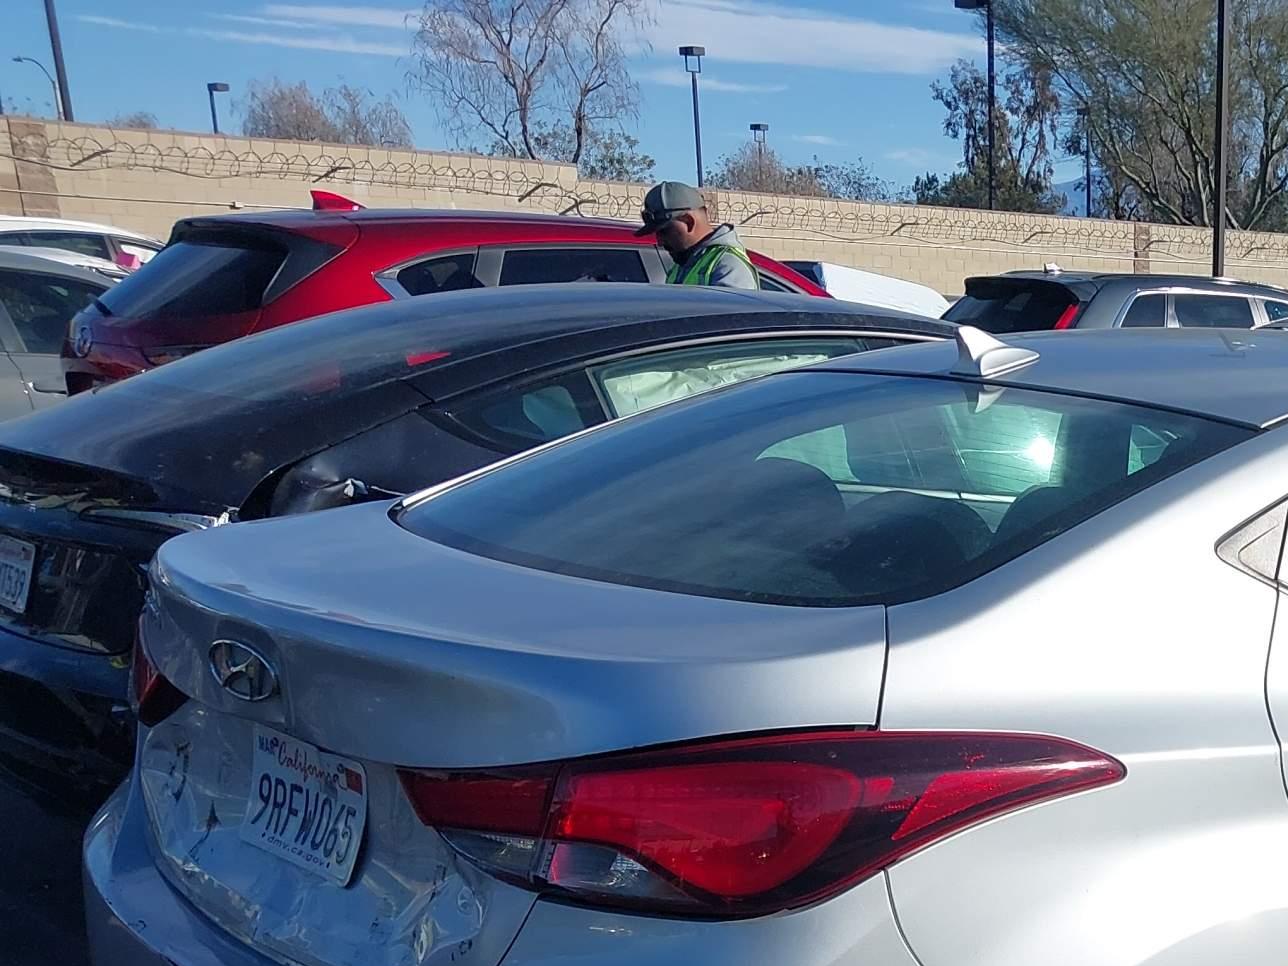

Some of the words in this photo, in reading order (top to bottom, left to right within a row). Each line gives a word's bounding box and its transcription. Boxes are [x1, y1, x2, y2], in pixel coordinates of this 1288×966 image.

[278, 741, 342, 786] California
[251, 772, 357, 864] 9RFW065
[267, 836, 325, 866] dmv.ca.gov
